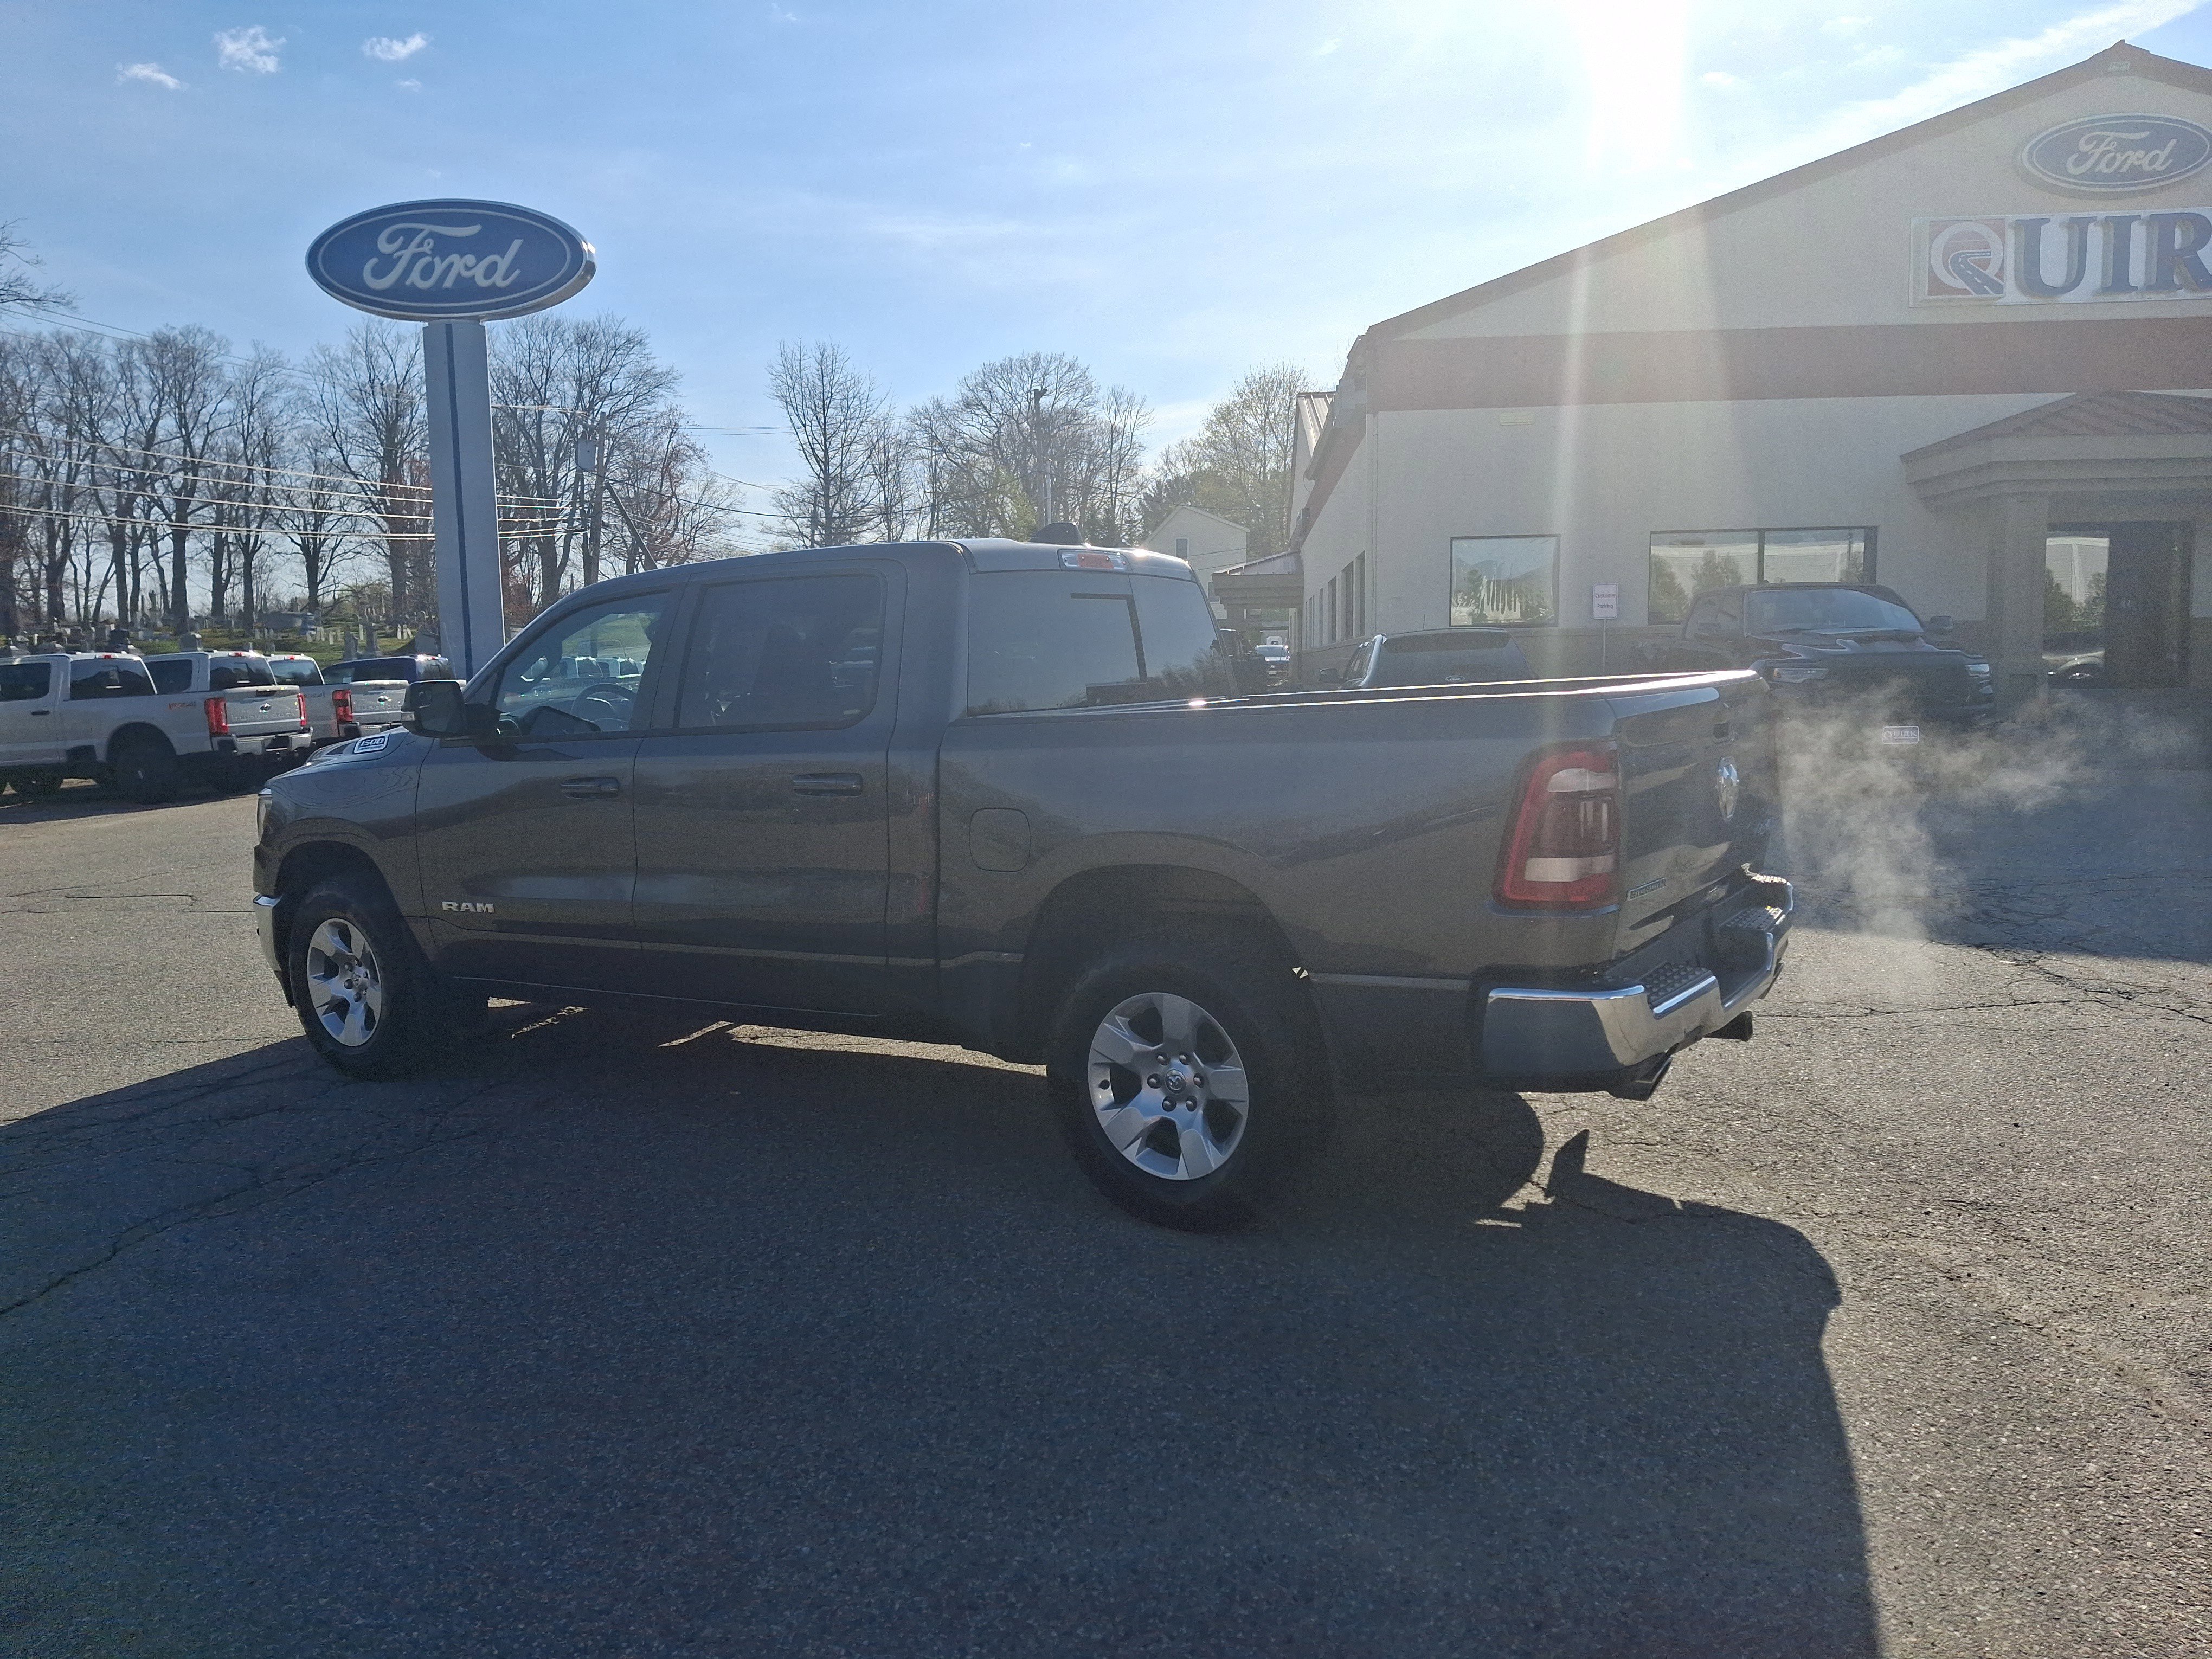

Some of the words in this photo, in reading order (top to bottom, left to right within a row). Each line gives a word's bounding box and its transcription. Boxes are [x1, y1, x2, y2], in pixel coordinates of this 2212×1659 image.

[2066, 131, 2177, 175] Ford
[363, 223, 524, 290] Ford
[1884, 730, 1917, 740] QUIRK
[361, 738, 384, 746] 1500
[442, 901, 494, 913] RAM
